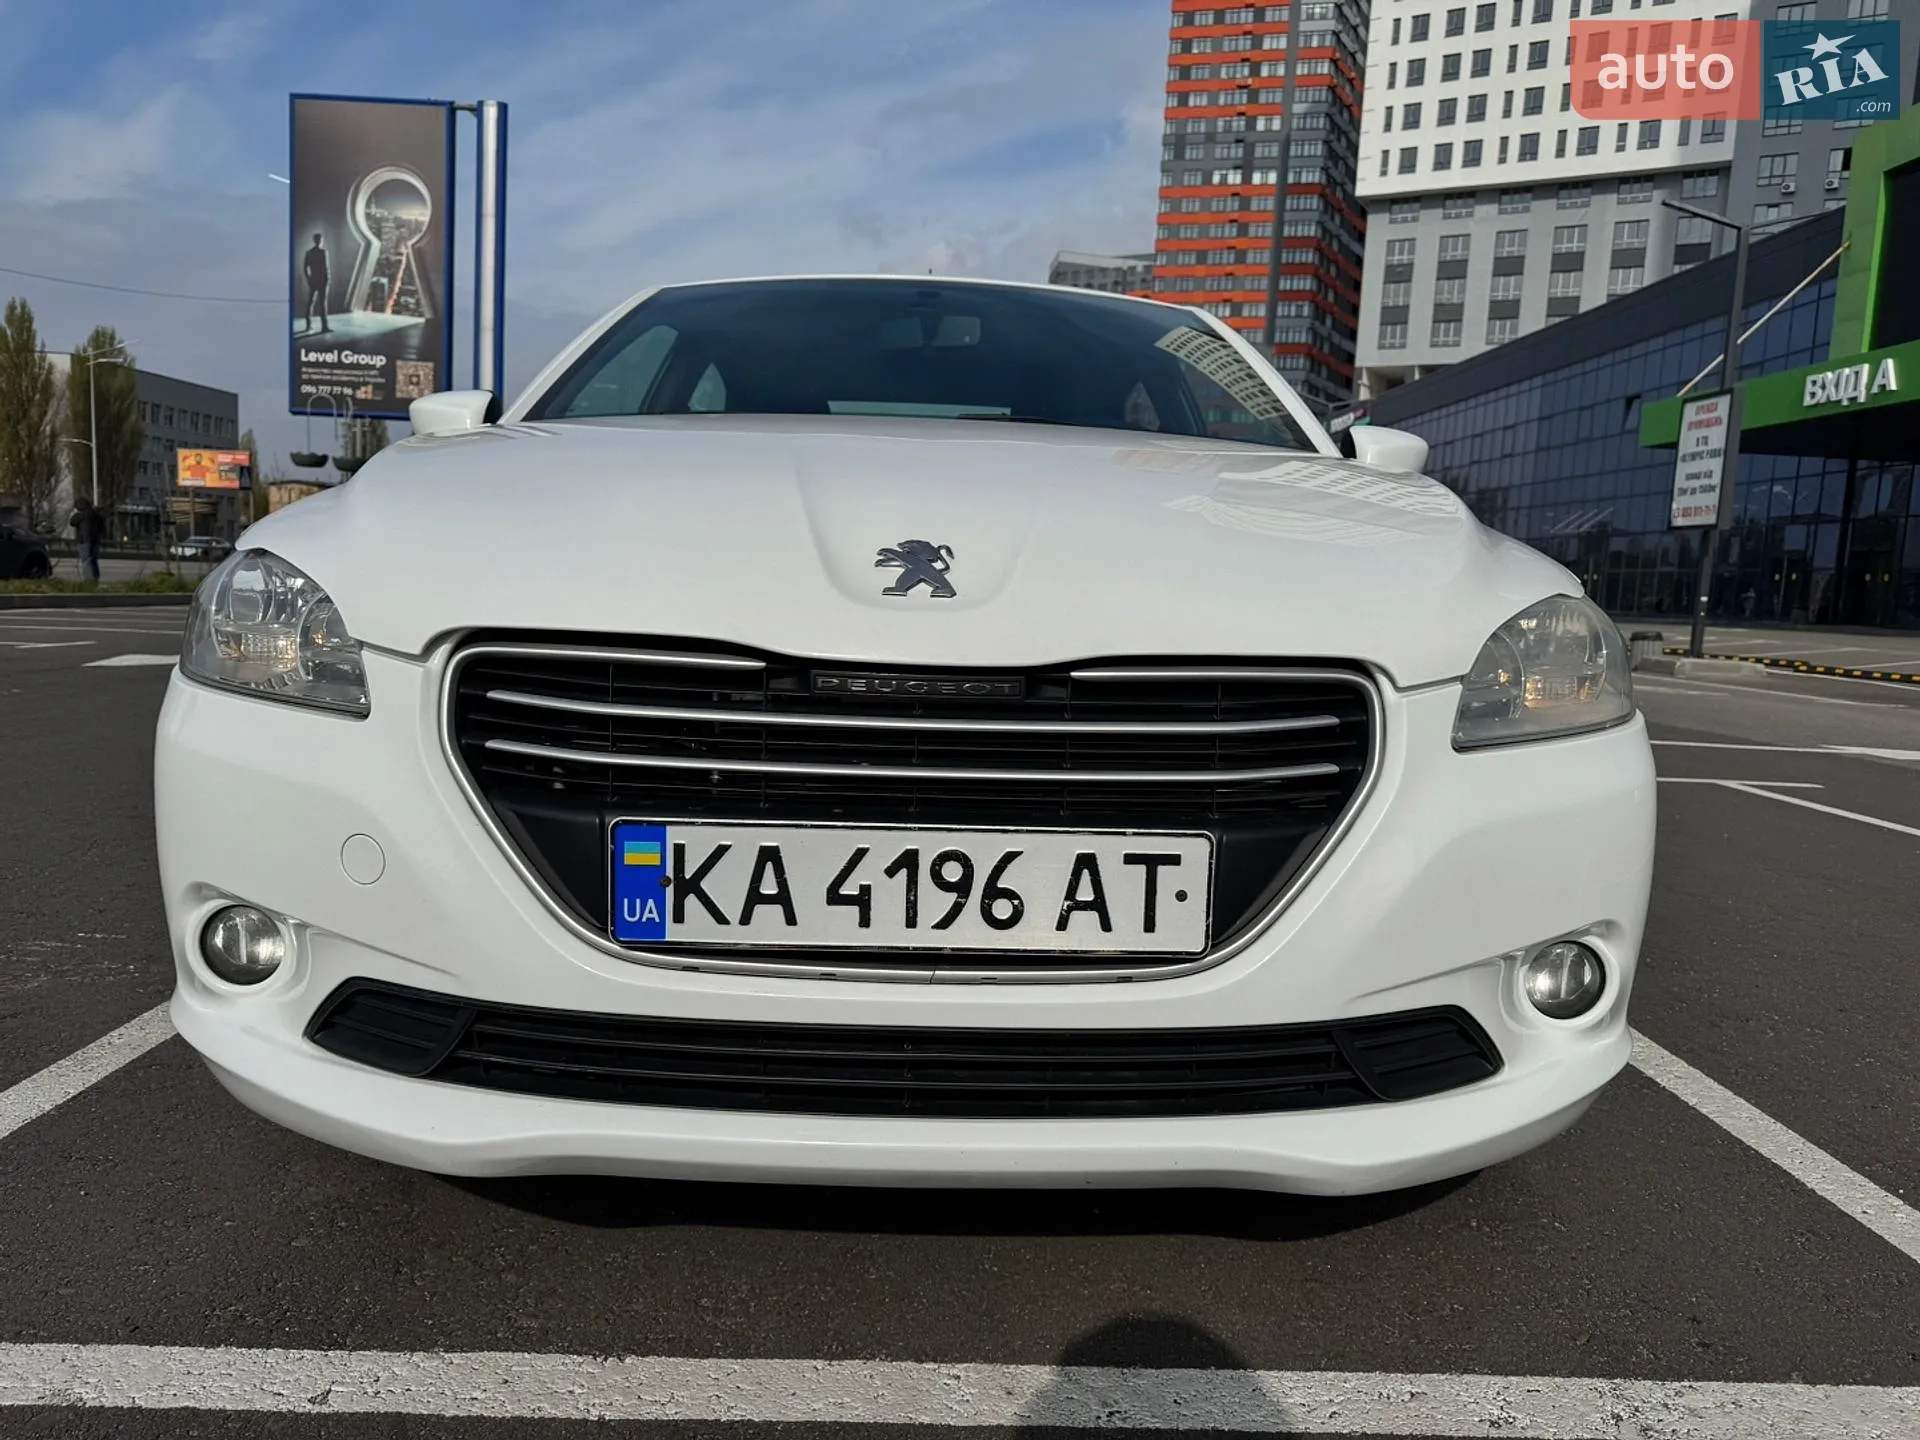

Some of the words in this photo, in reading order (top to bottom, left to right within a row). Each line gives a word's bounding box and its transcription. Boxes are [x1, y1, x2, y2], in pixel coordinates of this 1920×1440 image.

[301, 348, 338, 363] Level
[341, 350, 387, 368] Group
[1803, 363, 1870, 406] ВХІД
[672, 842, 798, 926] KA
[826, 846, 1025, 931] 4196
[1055, 852, 1182, 933] AT
[624, 898, 660, 923] UA
